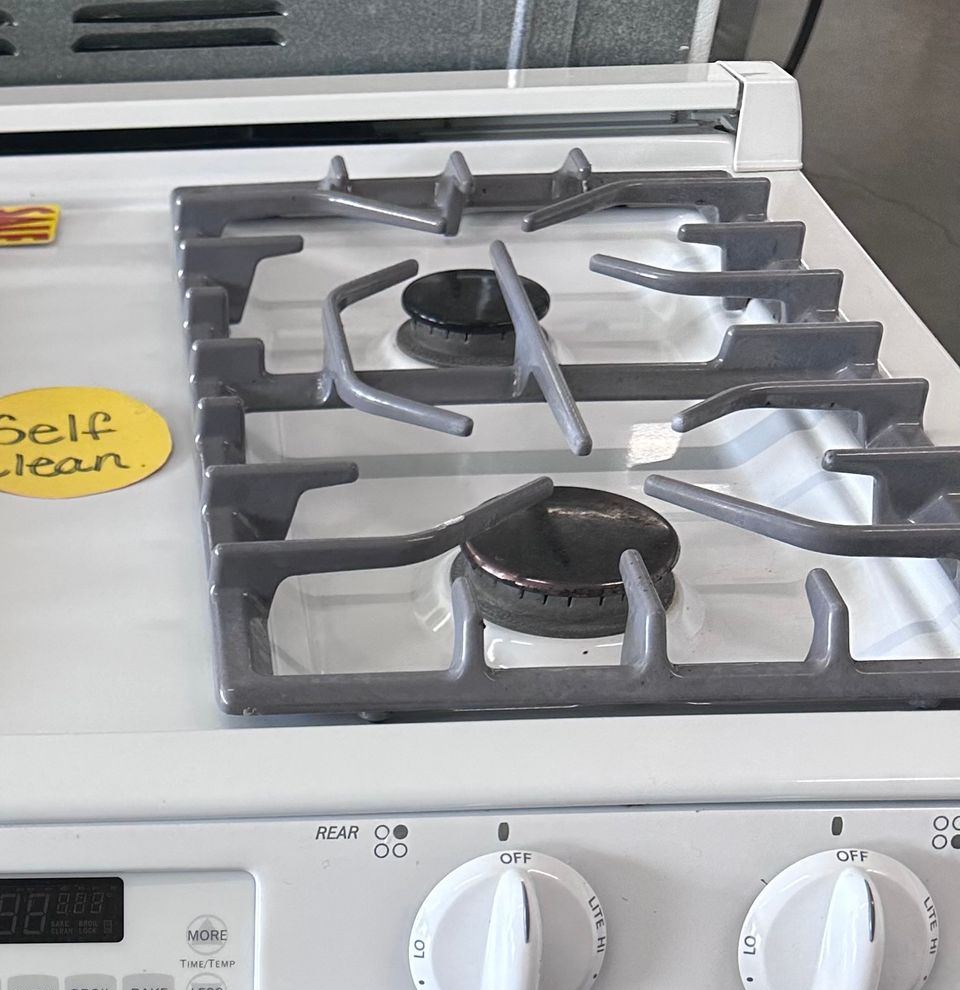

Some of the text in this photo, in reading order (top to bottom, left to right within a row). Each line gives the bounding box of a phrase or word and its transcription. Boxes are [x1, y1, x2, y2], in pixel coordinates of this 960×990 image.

[315, 825, 360, 840] REAR
[499, 851, 532, 865] OFF
[836, 849, 869, 862] OFF
[588, 895, 606, 953] LITE HI
[923, 896, 938, 955] LITE HI
[187, 929, 228, 942] MORE
[413, 939, 425, 959] LO
[743, 935, 756, 955] LO
